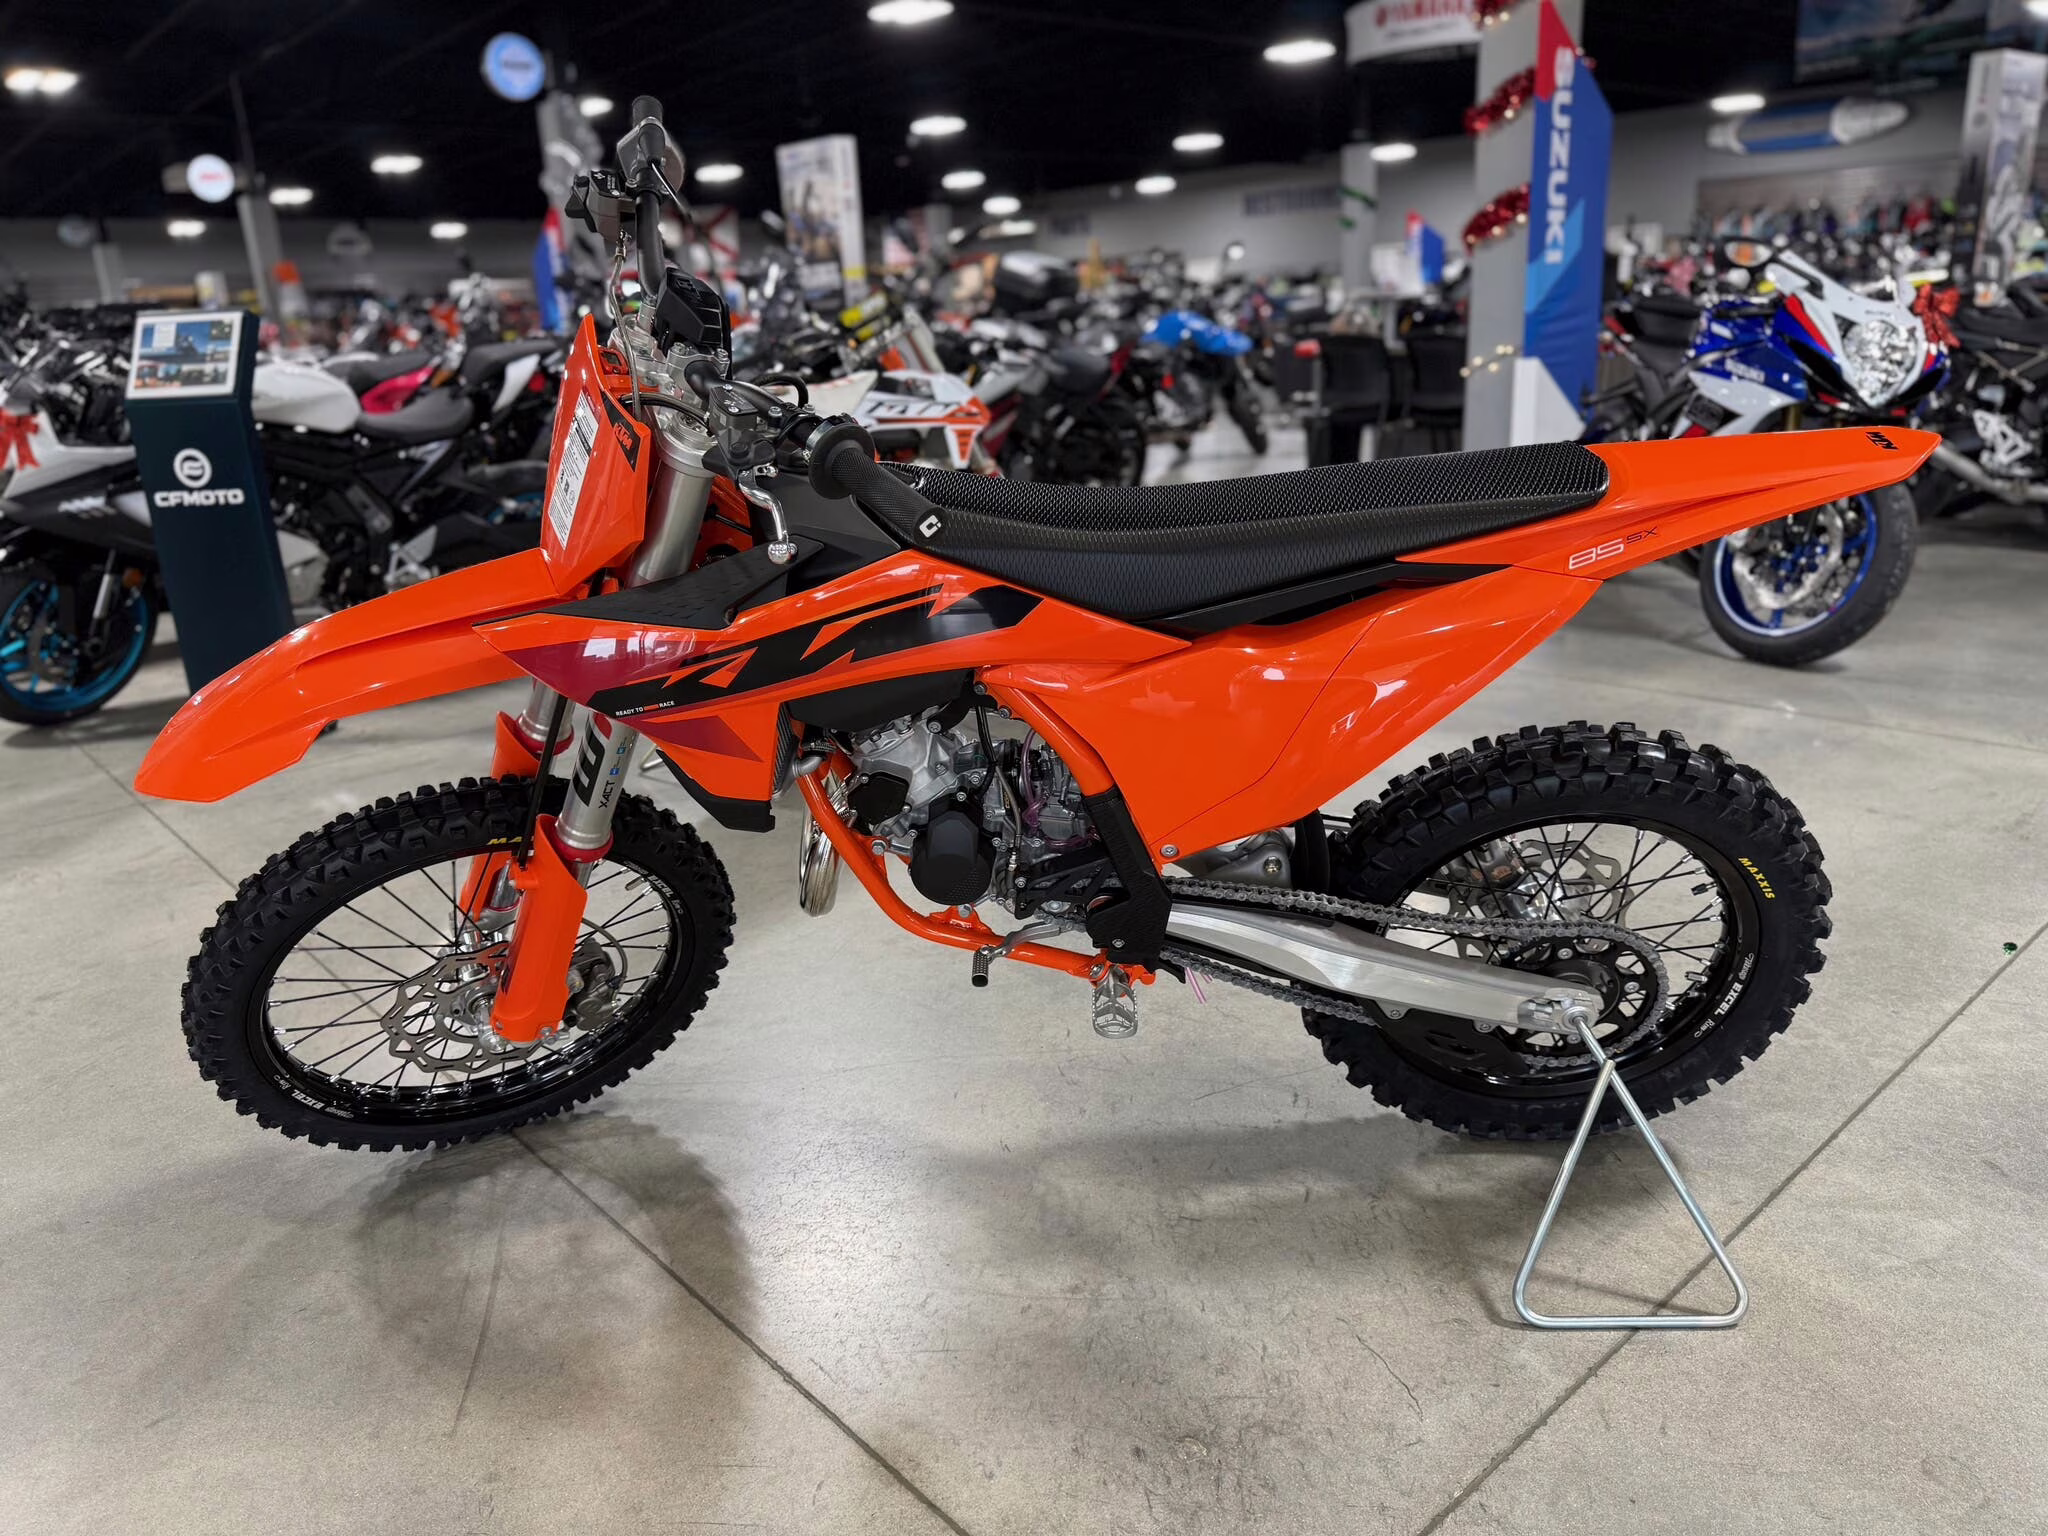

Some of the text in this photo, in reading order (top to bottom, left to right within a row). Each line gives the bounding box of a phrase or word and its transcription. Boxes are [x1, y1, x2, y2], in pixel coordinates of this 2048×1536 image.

[1545, 46, 1575, 264] SUZUKI
[613, 422, 633, 450] KTM
[1864, 431, 1899, 450] KTM
[153, 489, 245, 508] CFMOTO
[1568, 538, 1624, 571] 85
[615, 708, 635, 716] READY
[659, 700, 676, 708] RACE
[598, 780, 616, 809] XACT
[1738, 857, 1776, 899] MAXXIS
[1714, 982, 1744, 1015] EXCEL
[291, 1089, 325, 1110] EXCEL
